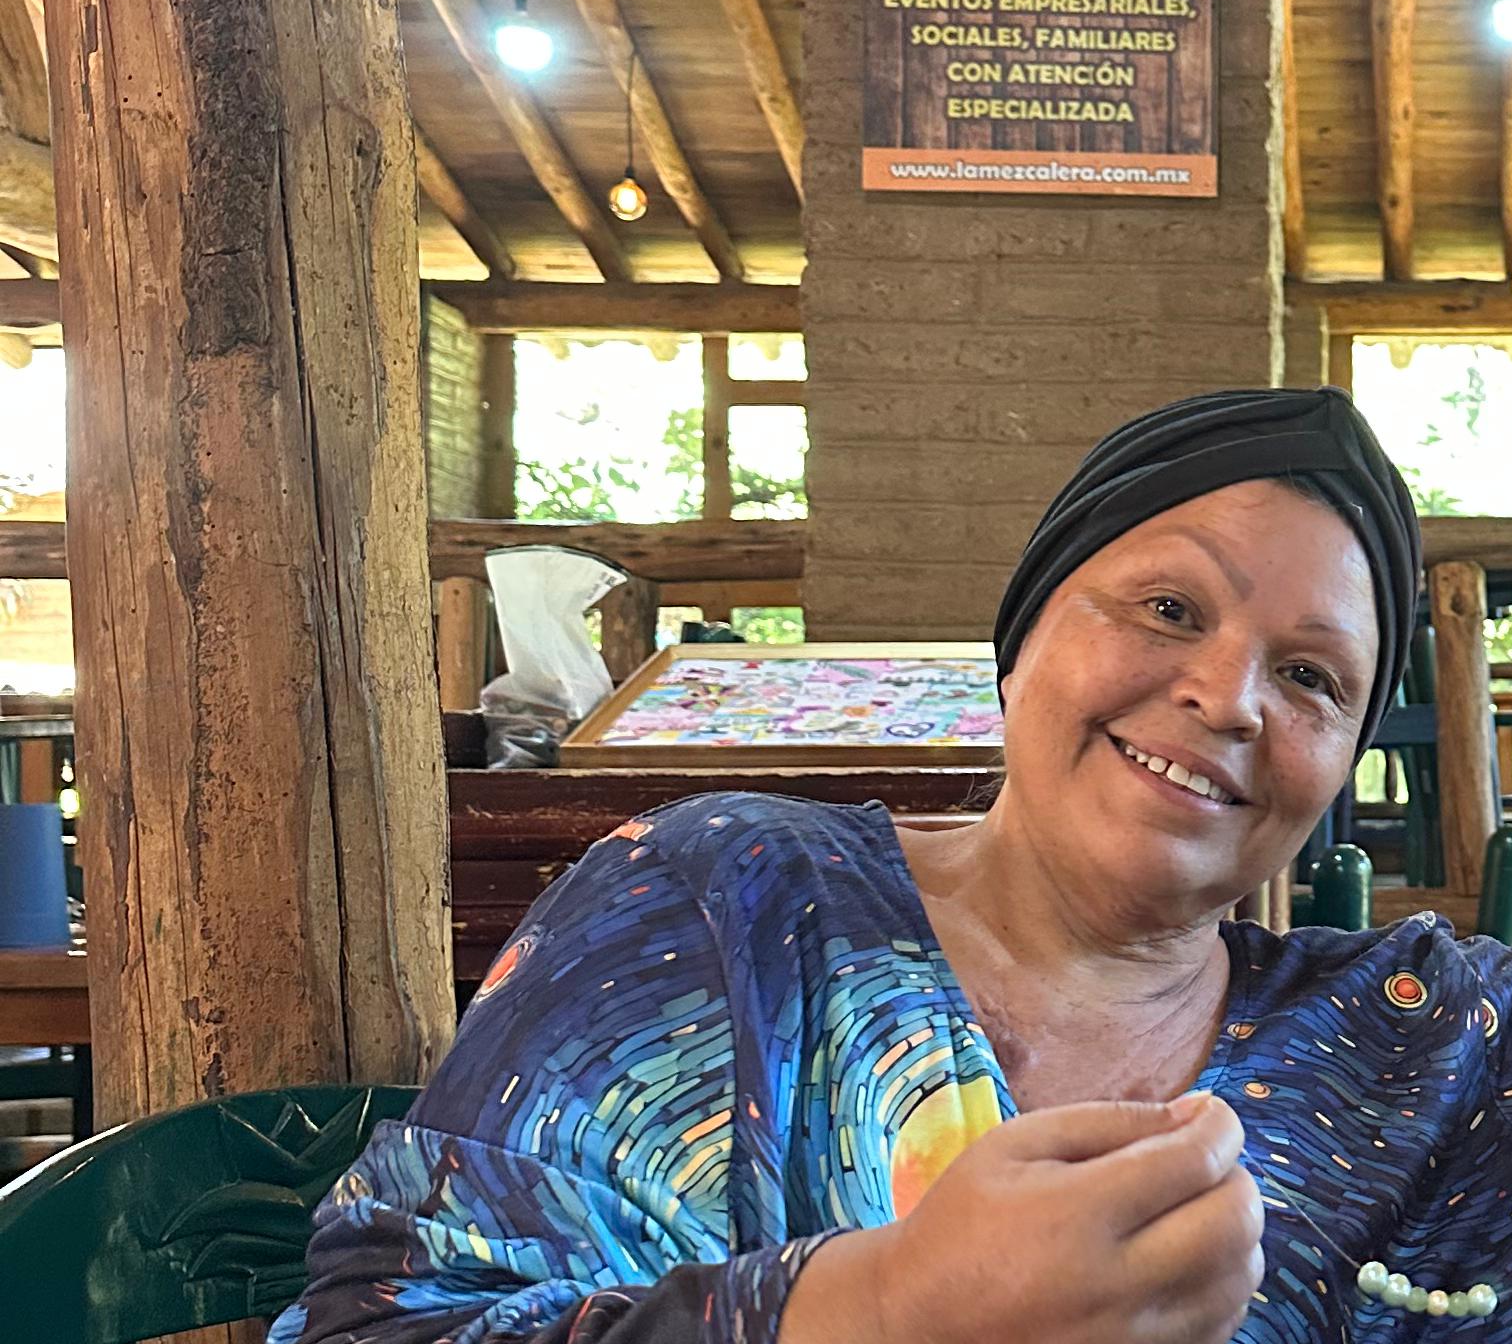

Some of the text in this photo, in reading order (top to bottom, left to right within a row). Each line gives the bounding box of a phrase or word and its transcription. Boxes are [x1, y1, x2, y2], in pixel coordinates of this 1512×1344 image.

[910, 25, 1177, 52] SOCIALES, FAMILIARES
[947, 61, 1134, 86] CON ATENCIÓN
[947, 99, 1134, 122] ESPECIALIZADA
[890, 160, 1190, 184] www.lamezcalera.com.mx
